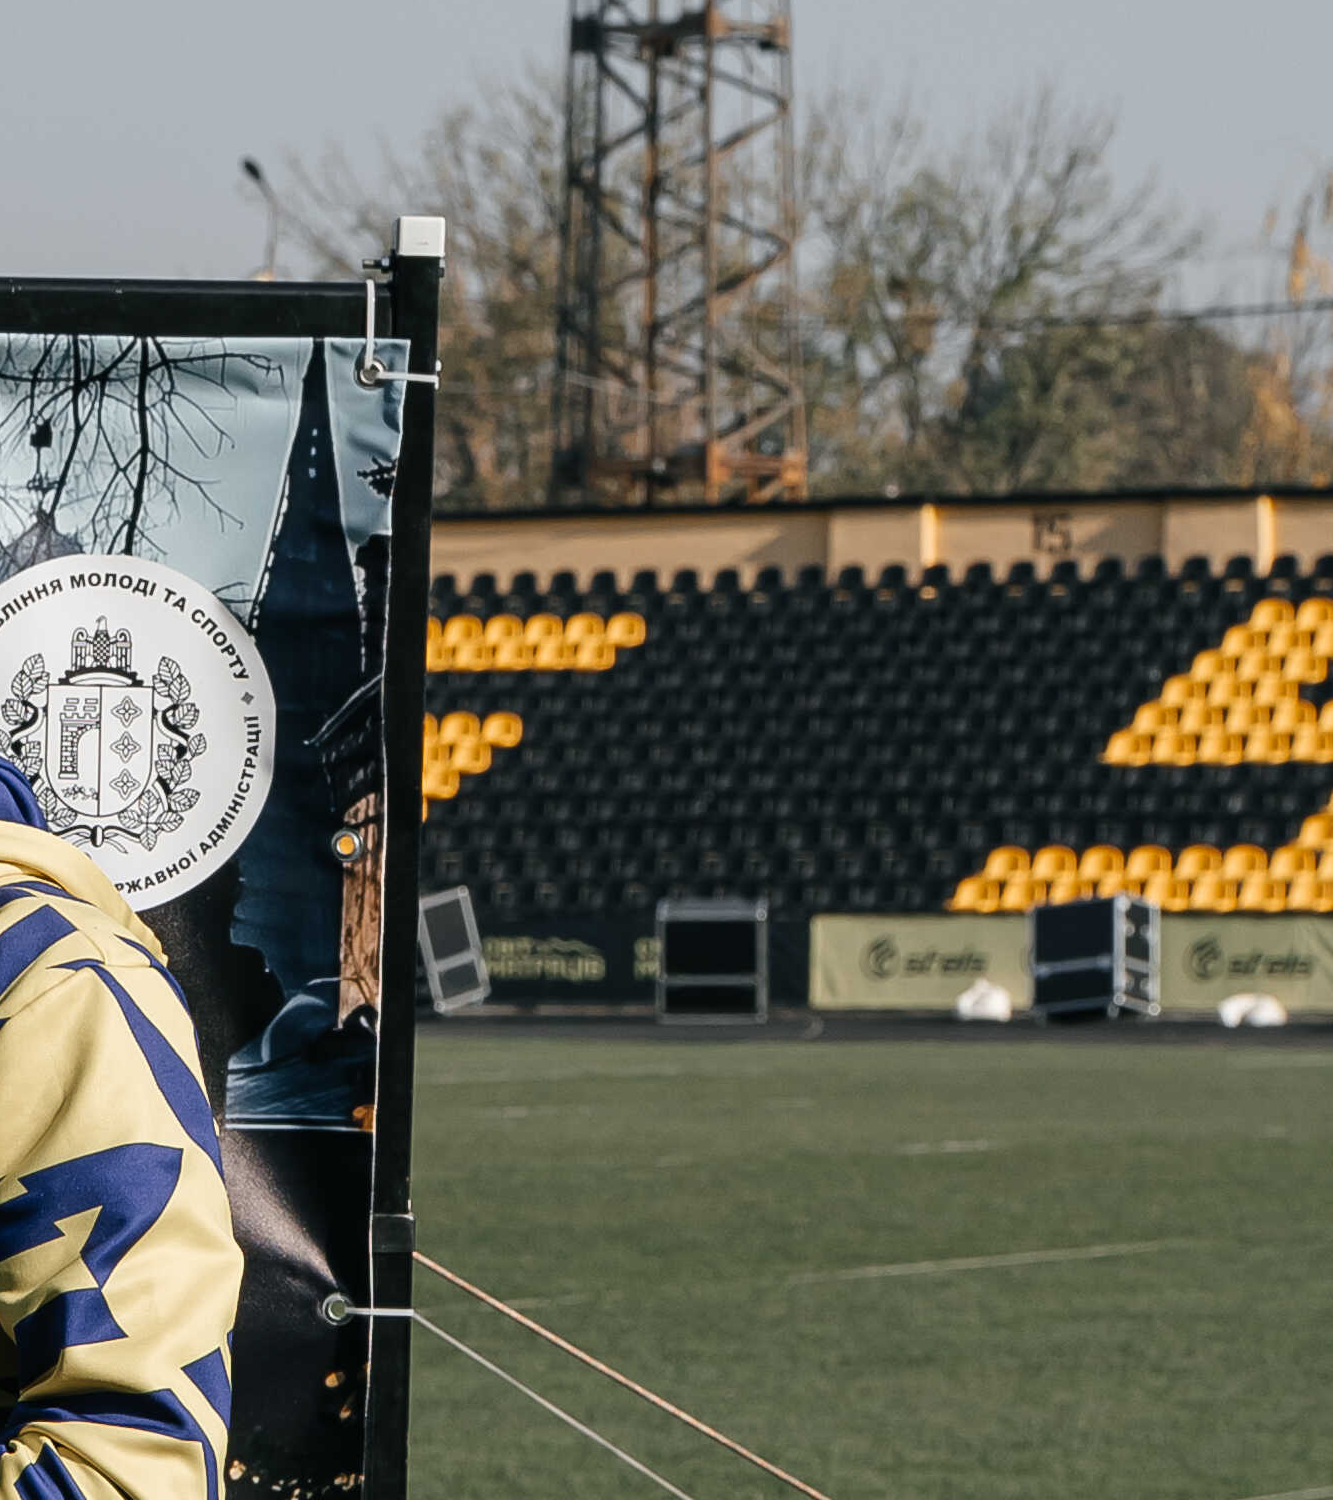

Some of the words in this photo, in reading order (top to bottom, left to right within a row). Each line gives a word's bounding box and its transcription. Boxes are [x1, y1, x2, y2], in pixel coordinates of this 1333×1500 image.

[69, 572, 157, 597] МОЛОДІ
[163, 587, 188, 612] ТА
[191, 608, 250, 682] СПОРТУ
[199, 715, 260, 856] АДМІНІСТРАЦІЇ
